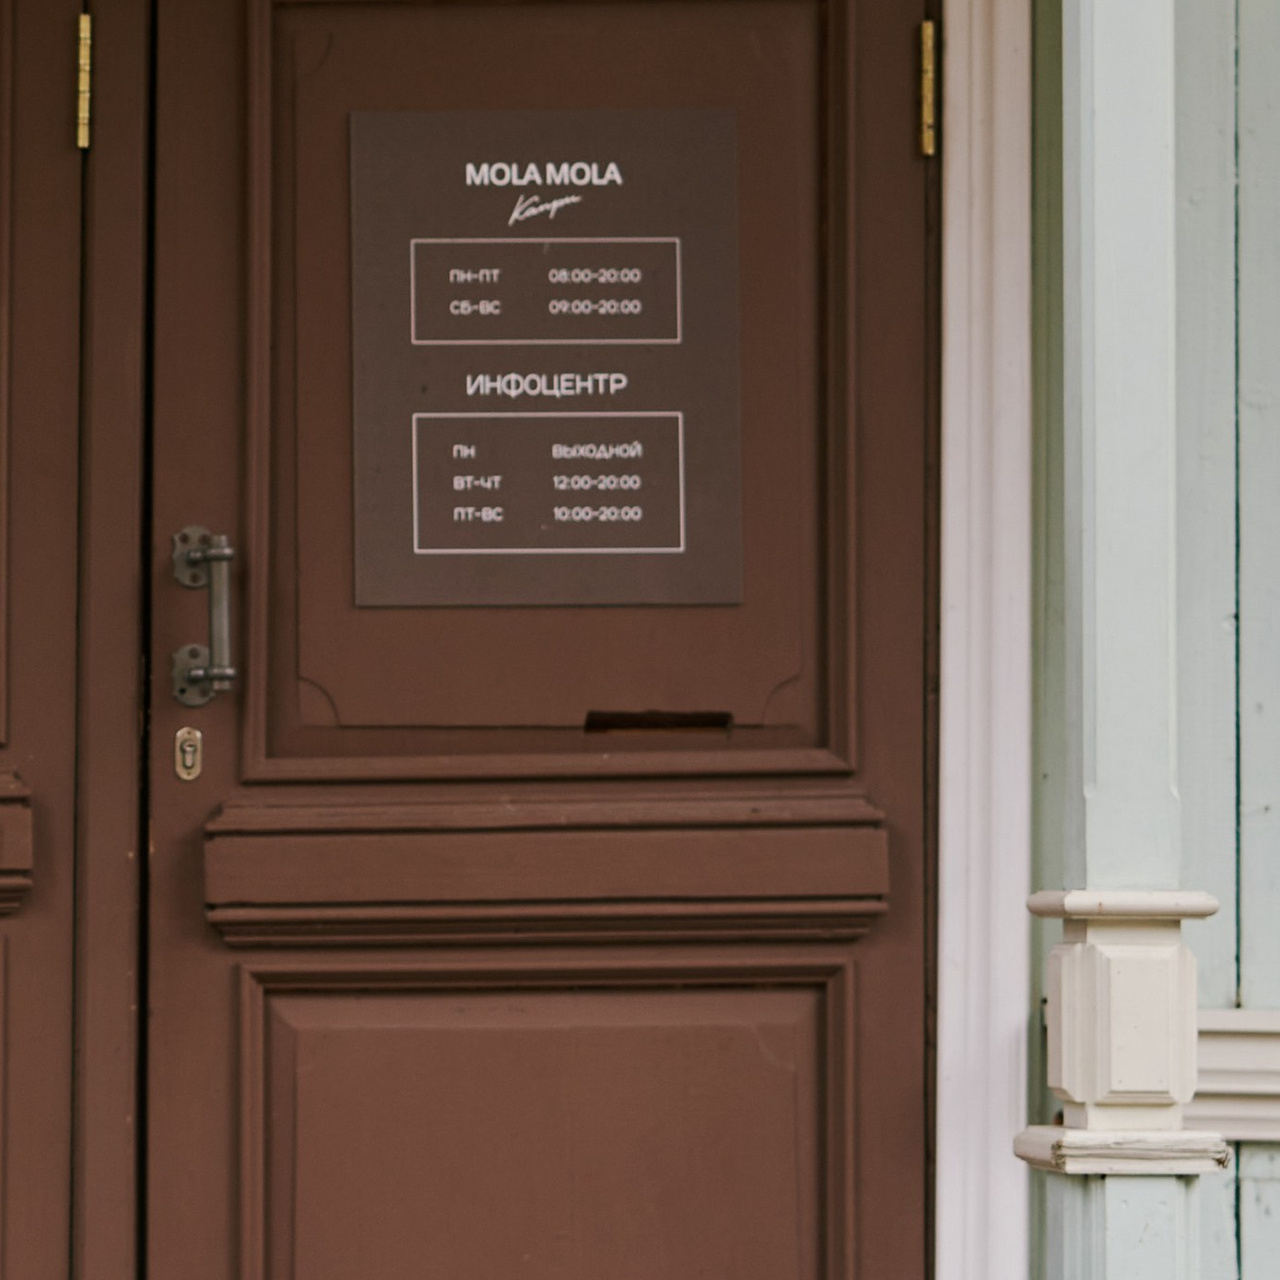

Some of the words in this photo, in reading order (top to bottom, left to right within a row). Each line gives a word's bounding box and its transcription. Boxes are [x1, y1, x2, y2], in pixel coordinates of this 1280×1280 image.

[466, 162, 542, 186] MOLA
[546, 162, 622, 186] MOLA
[449, 268, 501, 283] ПН-ПТ
[449, 300, 501, 315] СБ-ВС
[466, 373, 629, 398] ИНФОЦЕНТР
[452, 444, 476, 458] ПН
[552, 441, 642, 459] ВЫХОДНОЙ
[453, 476, 502, 490] ВТ-ЧТ
[553, 475, 642, 490] 12:00-20:00
[453, 506, 504, 521] ПТ-ВС
[553, 506, 642, 521] 10:00-20:00
